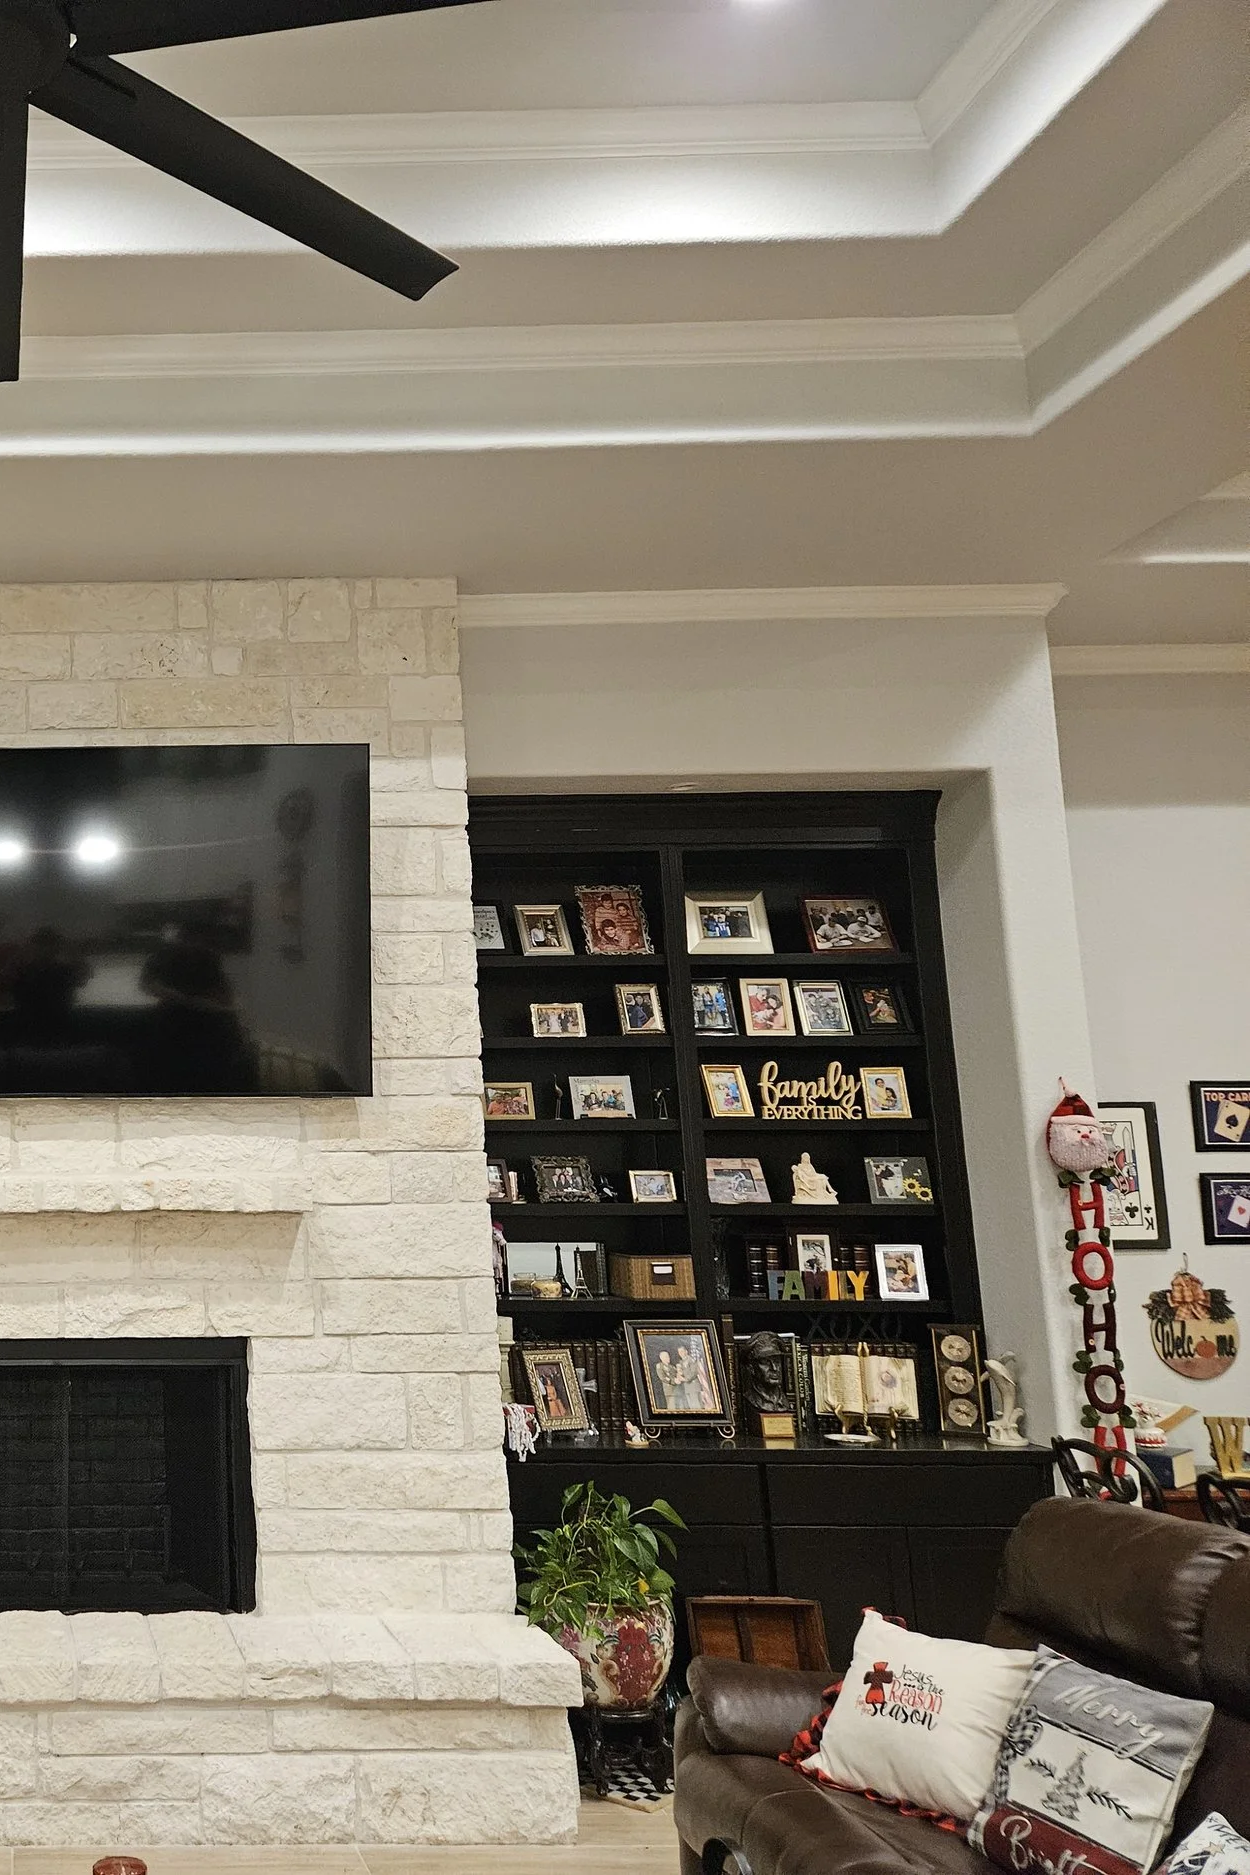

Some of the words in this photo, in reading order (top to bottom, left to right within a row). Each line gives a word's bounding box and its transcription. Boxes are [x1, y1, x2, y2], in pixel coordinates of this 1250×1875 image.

[757, 1061, 861, 1112] family
[1204, 1091, 1225, 1102] TOP
[762, 1106, 862, 1120] EVERYTHING
[802, 1095, 817, 1107] IS
[1144, 1217, 1155, 1230] K
[766, 1270, 869, 1301] FAMILY
[1203, 1416, 1250, 1479] W
[893, 1664, 934, 1685] Jesus
[888, 1679, 943, 1714] Reason
[927, 1683, 944, 1695] the
[870, 1700, 938, 1731] season
[1052, 1685, 1165, 1759] Merry
